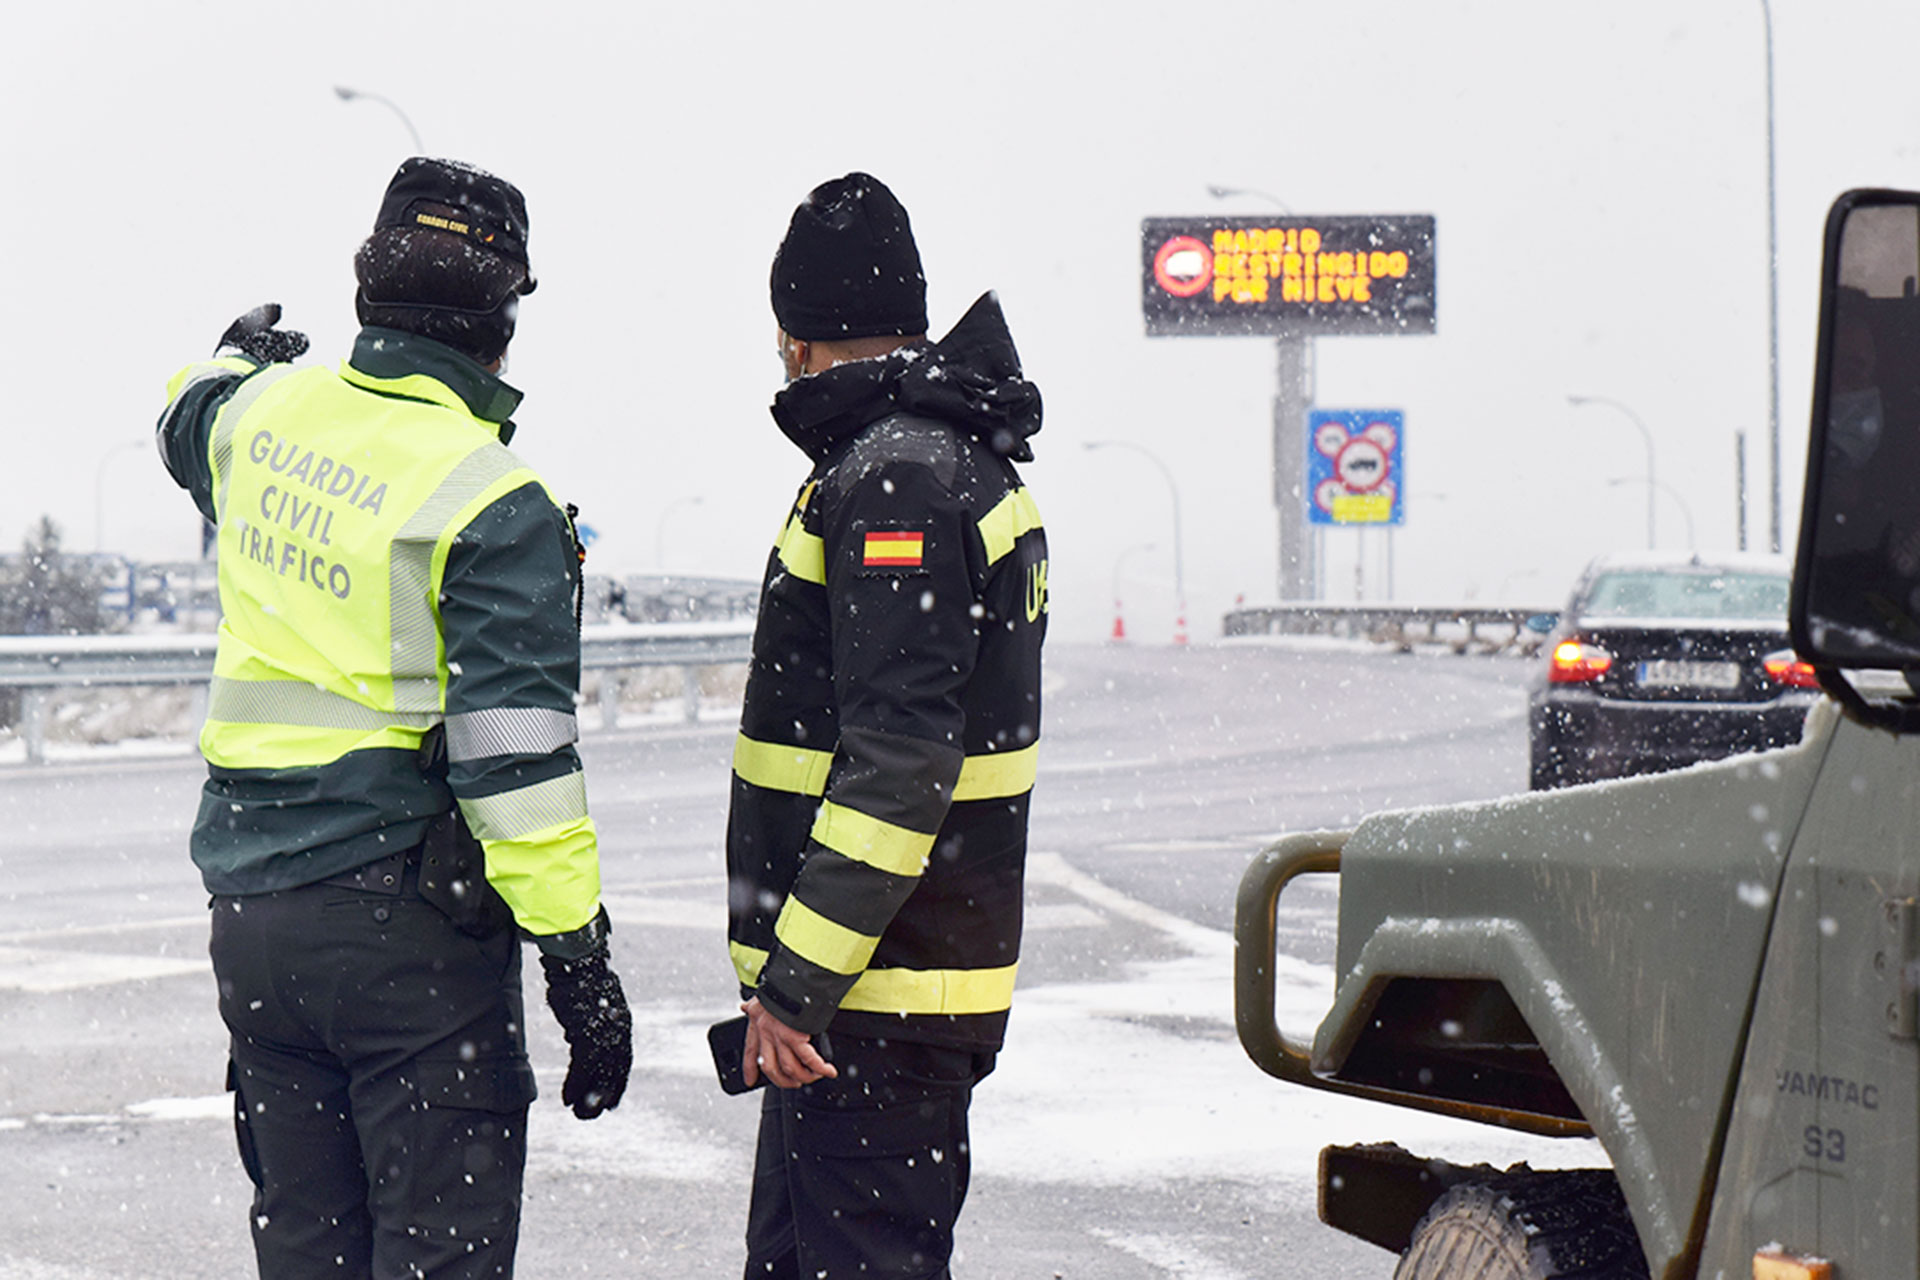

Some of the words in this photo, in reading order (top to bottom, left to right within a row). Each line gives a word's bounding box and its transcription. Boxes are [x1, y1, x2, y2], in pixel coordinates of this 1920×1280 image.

[1213, 228, 1321, 251] MADRID
[1213, 251, 1408, 278] RESTRINGIDO
[1213, 277, 1269, 303] POR
[1282, 276, 1372, 303] NIEVE
[249, 430, 388, 516] GUARDIA
[261, 485, 334, 546] CIVIL
[238, 522, 351, 600] TRAFICO
[1775, 1068, 1879, 1111] VAMTAC
[1803, 1124, 1846, 1162] S3
